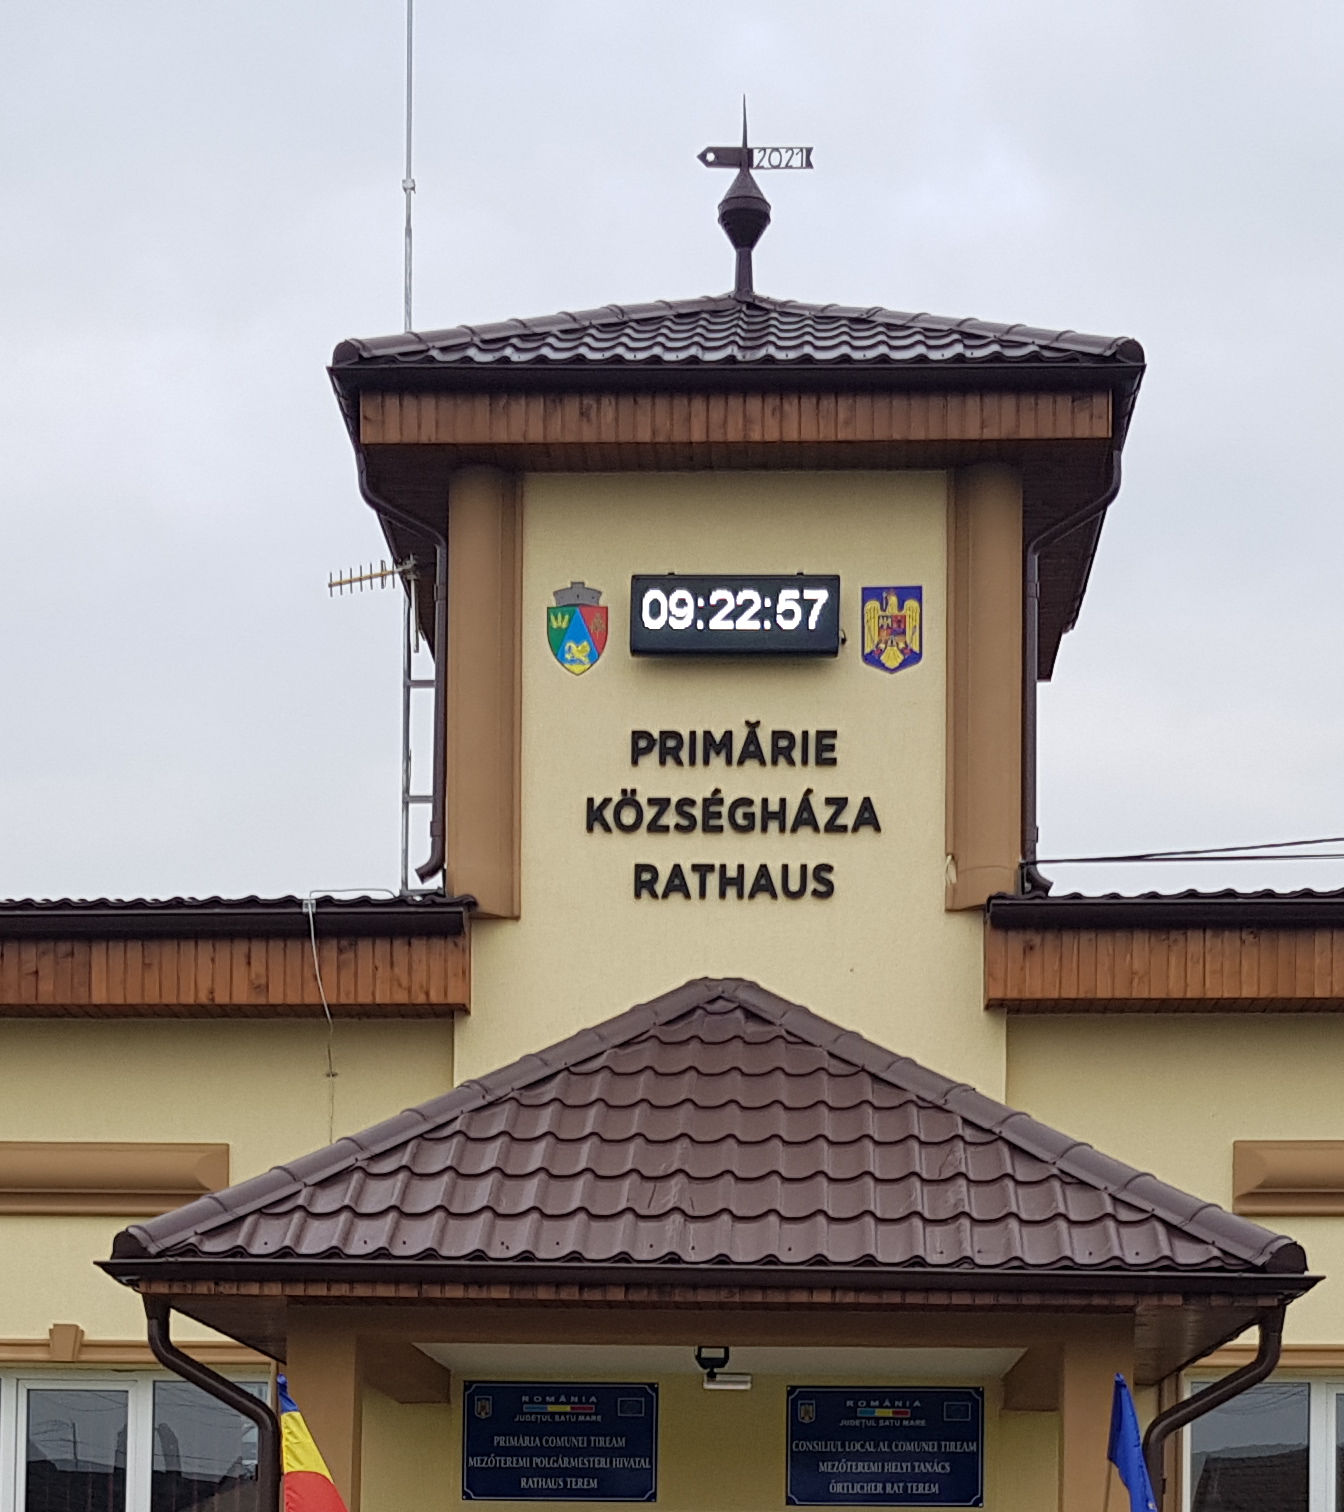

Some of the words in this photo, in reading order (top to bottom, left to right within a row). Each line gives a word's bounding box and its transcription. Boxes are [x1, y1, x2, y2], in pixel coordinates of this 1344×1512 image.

[756, 148, 805, 168] 2021
[642, 588, 829, 630] 09:22:57
[631, 720, 838, 767] PRIMĂRIE
[586, 788, 881, 834] KÖZSÉGHÁZA
[634, 863, 835, 899] RATHAUS
[521, 1394, 597, 1403] ROMÂNIA
[846, 1398, 921, 1407] ROMÂNIA
[542, 1436, 588, 1447] COMUNEI
[590, 1436, 626, 1447] TIREAM
[792, 1440, 844, 1451] CONSILIUL
[845, 1441, 876, 1451] LOCAL
[878, 1441, 890, 1451] AL
[892, 1441, 938, 1451] COMUNEI
[940, 1441, 977, 1452] TIREAM
[532, 1454, 610, 1468] POLGÁRMESTERI
[612, 1457, 651, 1468] HIVATAL
[884, 1462, 911, 1472] HELYI
[913, 1459, 950, 1472] TANÁCS
[520, 1478, 564, 1488] RATHAUS
[566, 1478, 598, 1488] TEREM
[885, 1483, 905, 1493] RAT
[907, 1482, 939, 1493] TEREM
